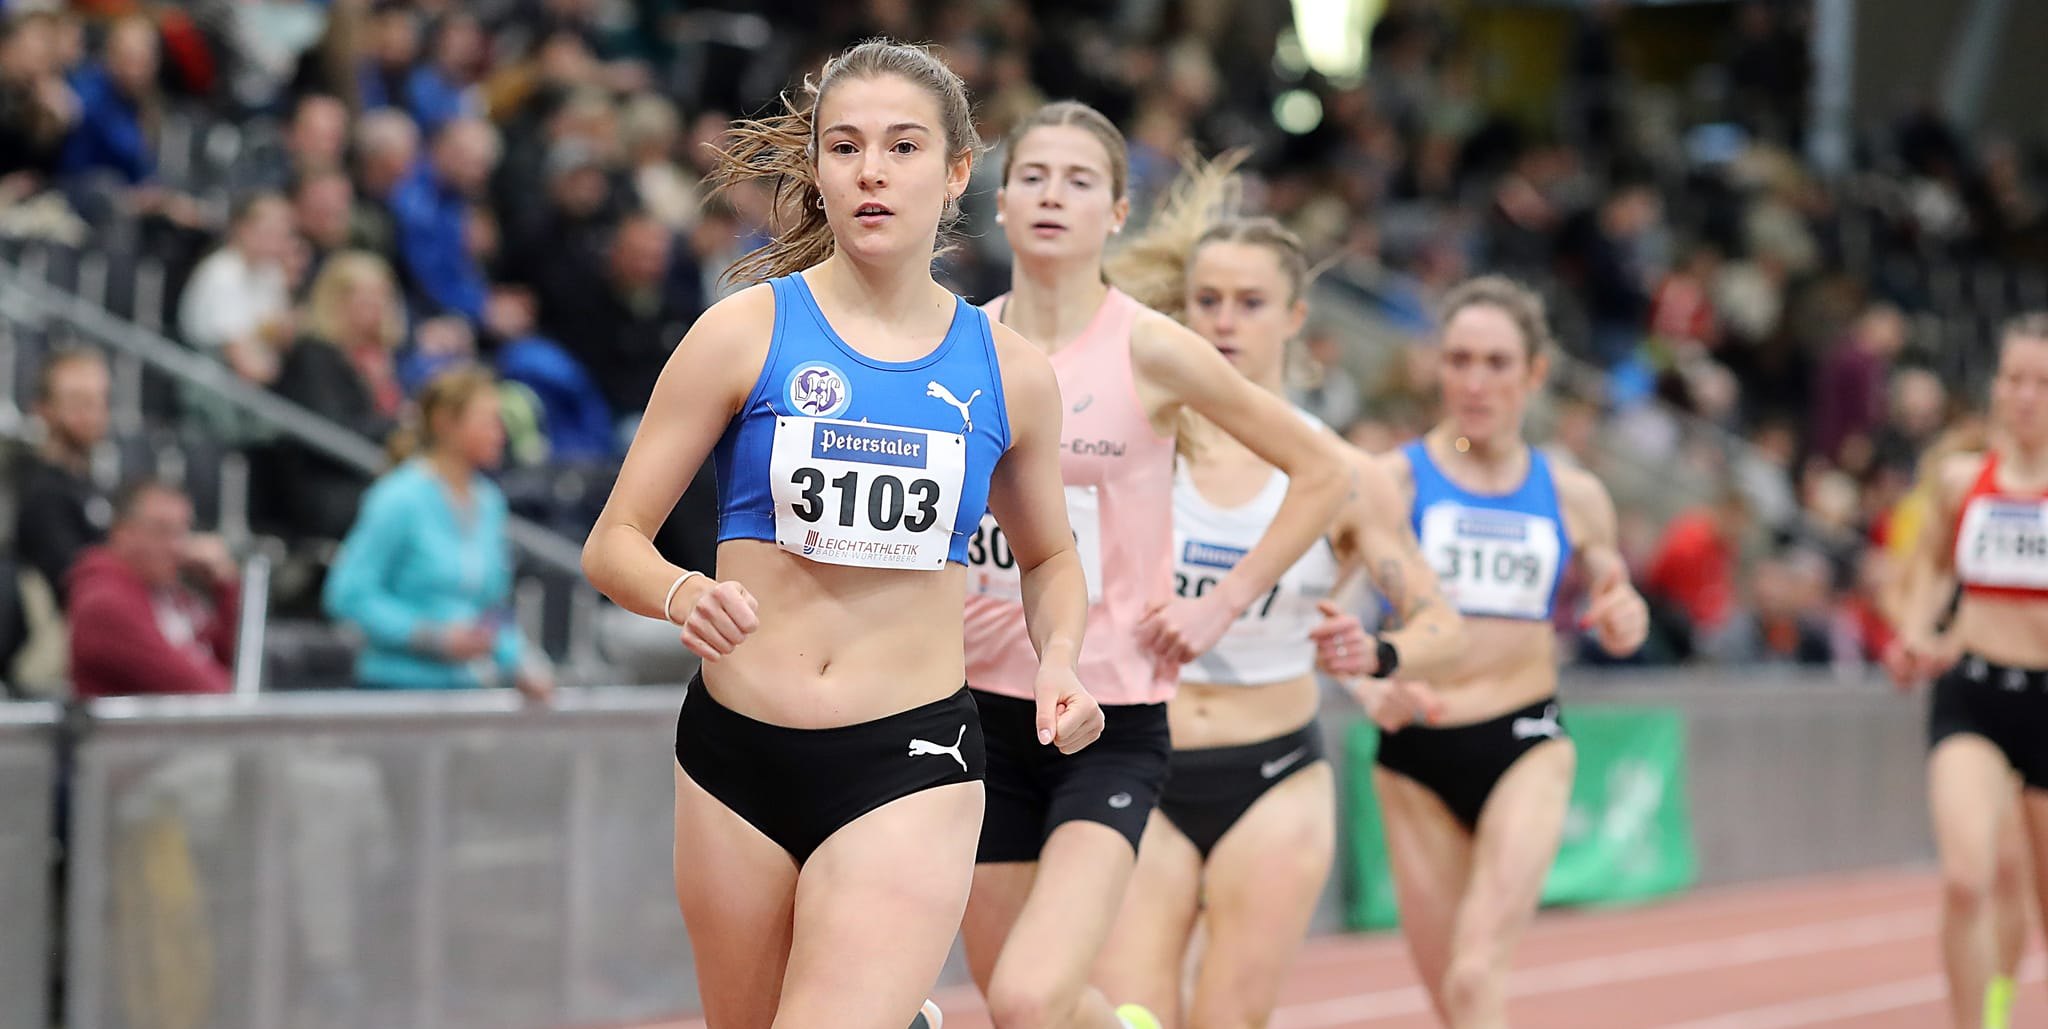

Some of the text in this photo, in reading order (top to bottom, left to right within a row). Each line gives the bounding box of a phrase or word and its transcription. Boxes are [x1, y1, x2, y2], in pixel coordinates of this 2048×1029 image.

[820, 429, 921, 457] Peterstaler
[790, 467, 940, 533] 3103
[818, 537, 919, 556] LEICHTATHLETIK
[1440, 546, 1539, 587] 3109
